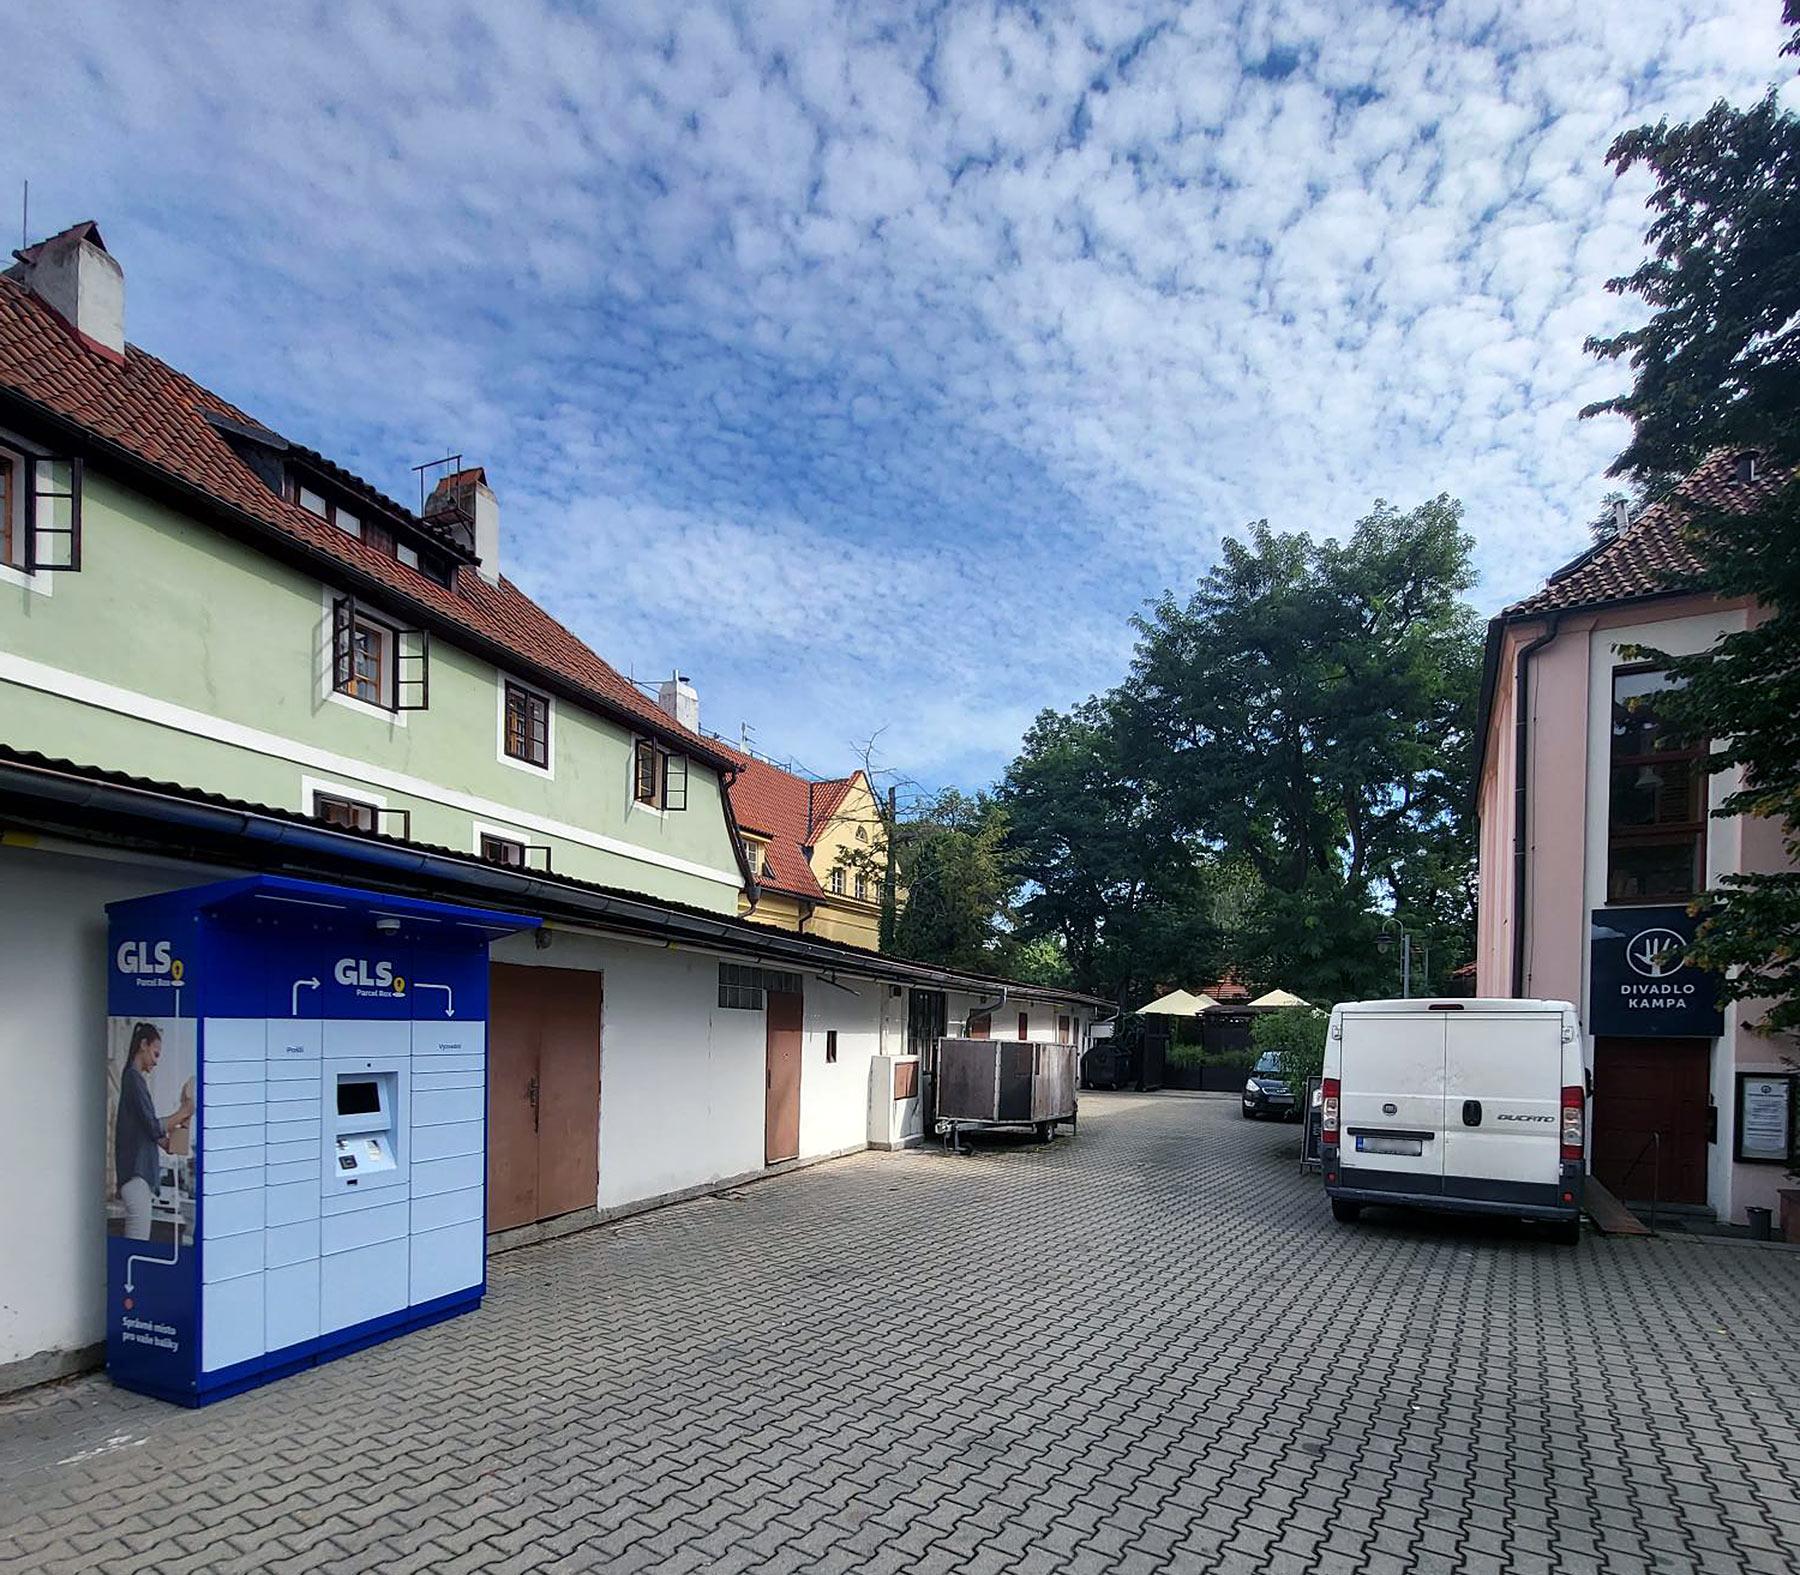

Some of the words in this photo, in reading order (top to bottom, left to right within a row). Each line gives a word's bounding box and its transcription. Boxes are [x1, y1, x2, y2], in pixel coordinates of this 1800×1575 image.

[117, 941, 171, 973] GLS
[334, 958, 393, 987] GLS
[356, 989, 378, 997] Parcel
[1621, 984, 1695, 994] DIVADLO
[1628, 998, 1686, 1008] KAMPA
[1497, 1114, 1555, 1122] DUCATO
